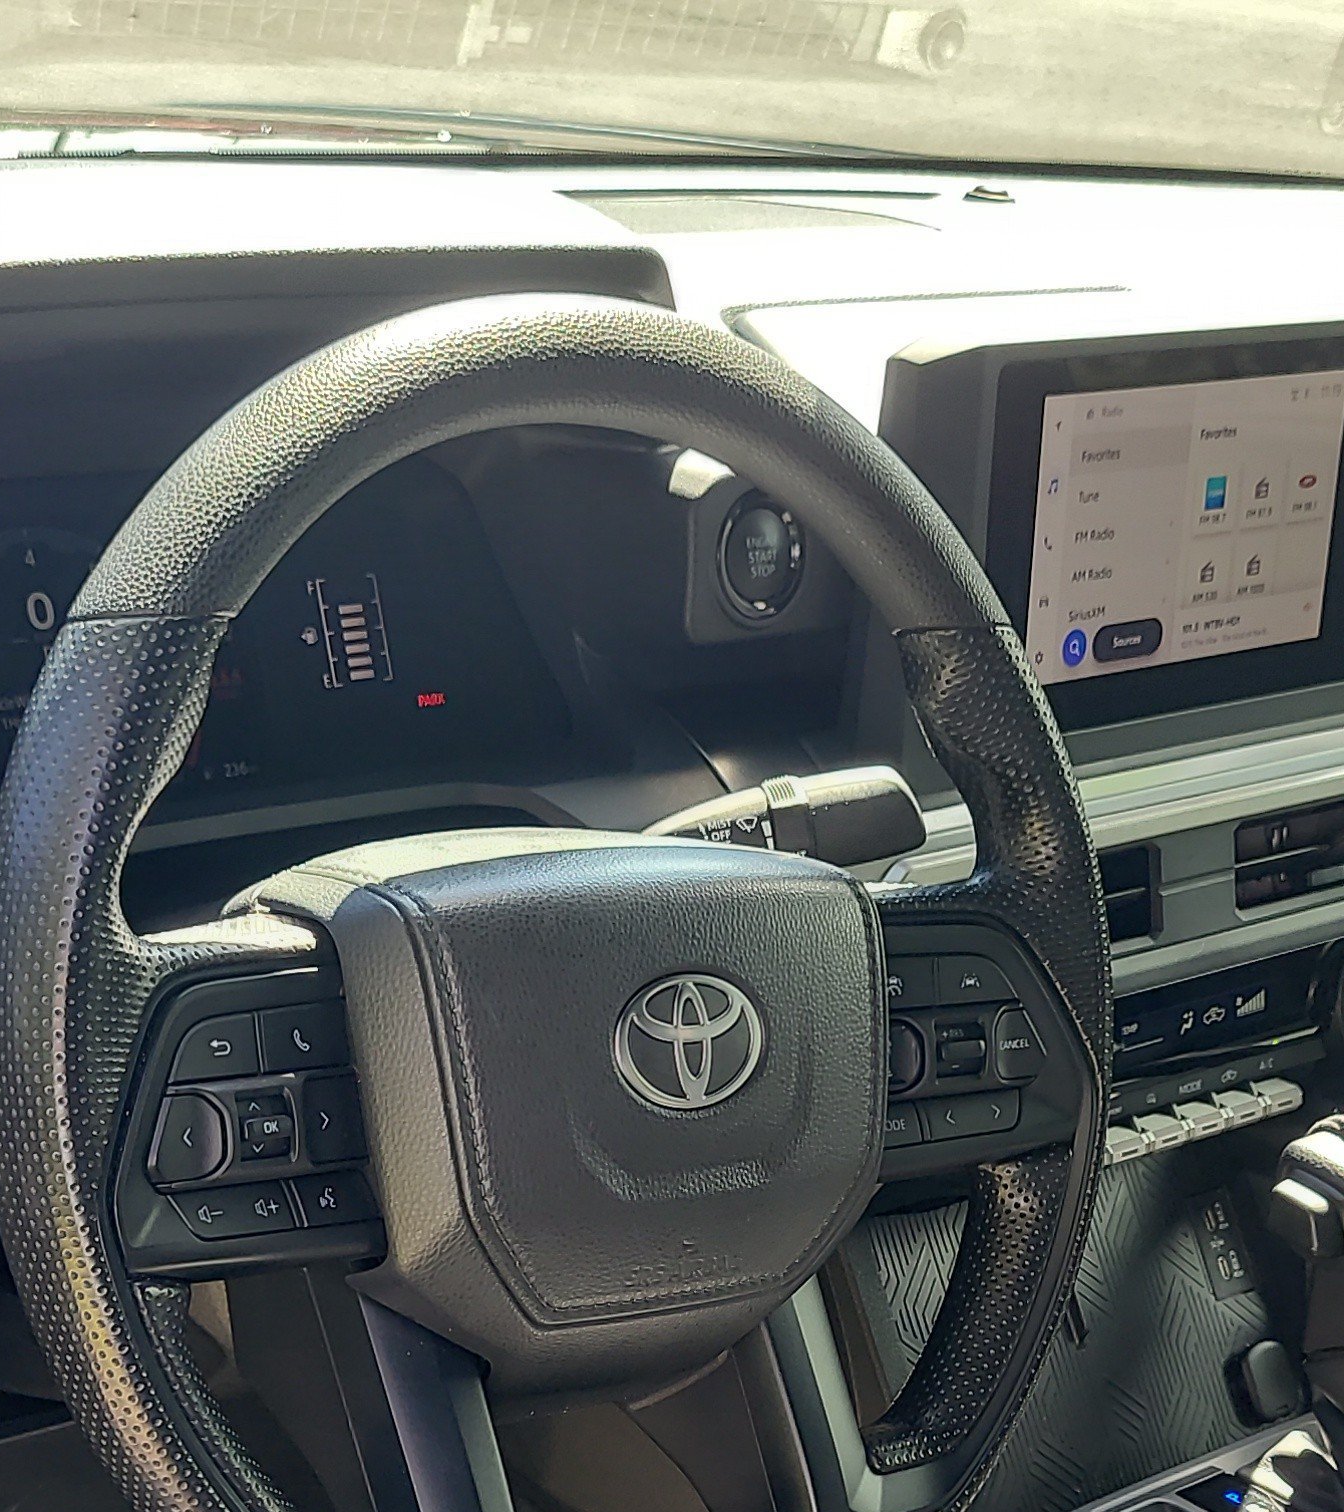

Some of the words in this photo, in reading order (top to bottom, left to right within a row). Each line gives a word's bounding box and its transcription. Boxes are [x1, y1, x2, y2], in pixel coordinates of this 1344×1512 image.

[1199, 426, 1238, 441] Favorites
[1081, 448, 1121, 463] Favorites
[1078, 490, 1100, 504] Tune
[1074, 530, 1089, 544] FM
[1090, 527, 1115, 542] Radio
[749, 549, 776, 563] START
[751, 563, 776, 578] STOP
[1071, 570, 1087, 582] AM
[1088, 566, 1112, 581] Radio
[26, 592, 55, 631] 0
[1068, 605, 1106, 622] SiriusXM
[706, 819, 732, 832] MIST
[710, 829, 732, 843] OFF
[999, 1038, 1030, 1051] CANCEL
[263, 1119, 280, 1135] OK
[885, 1118, 906, 1132] ODE
